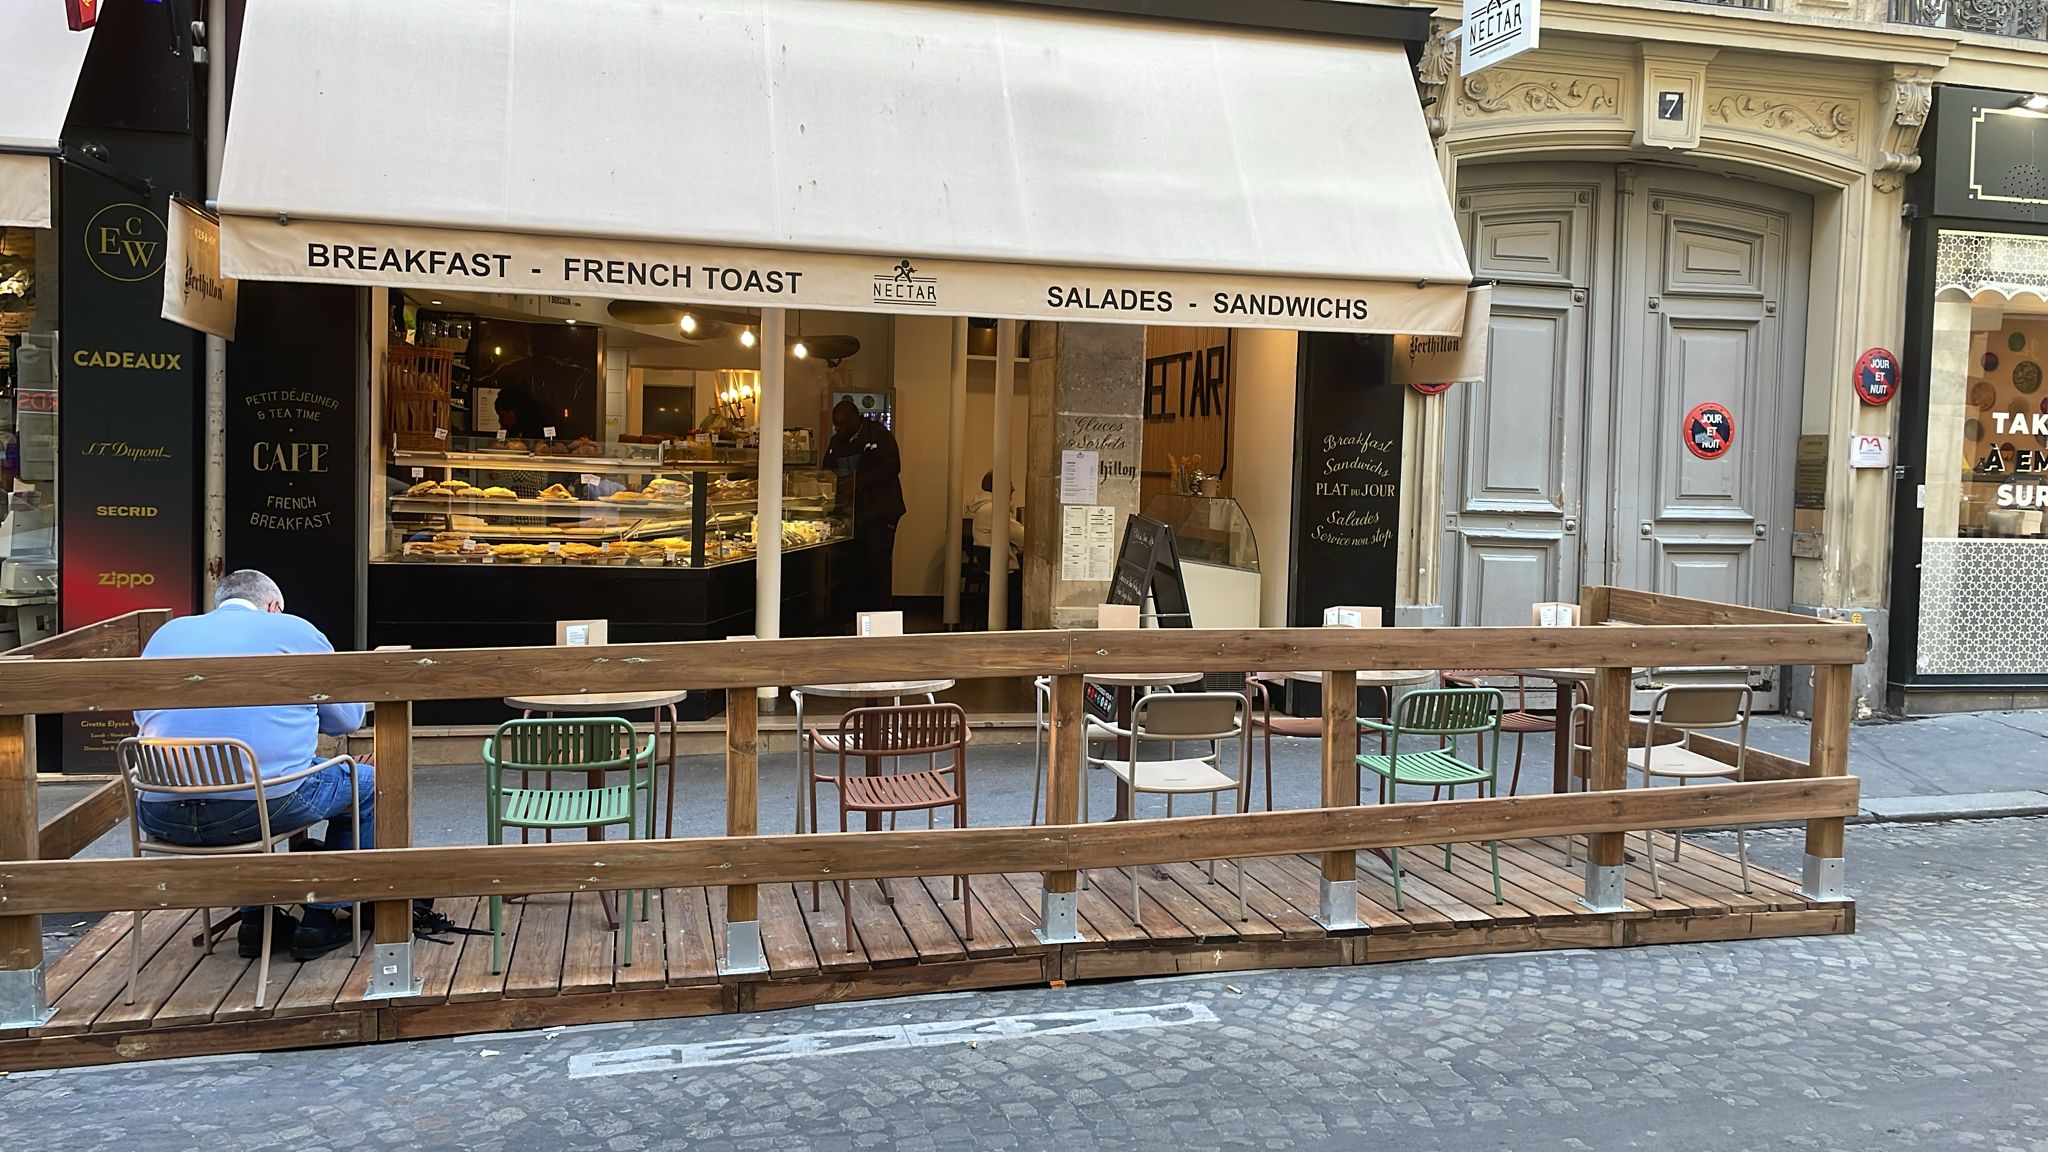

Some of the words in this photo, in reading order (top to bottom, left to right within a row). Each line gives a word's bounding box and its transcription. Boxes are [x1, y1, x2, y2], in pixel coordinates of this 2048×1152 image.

[1469, 3, 1521, 46] NECTAR
[1665, 93, 1680, 118] 7
[308, 243, 512, 278] BREAKFAST
[564, 258, 691, 288] FRENCH
[702, 267, 803, 294] TOAST
[873, 282, 937, 300] NECTAR
[1047, 285, 1173, 312] SALADES
[1213, 292, 1368, 320] SANDWICHS
[73, 350, 182, 370] CADEAUX
[1870, 359, 1889, 369] JOUR
[1144, 346, 1225, 422] ECTAR
[1875, 372, 1885, 381] ET
[245, 391, 278, 406] PETIT
[281, 387, 339, 410] DÉJEUNER
[1870, 385, 1888, 394] NUIT
[269, 408, 292, 418] TEA
[295, 408, 321, 421] TIME
[1701, 414, 1723, 424] JOUR
[1707, 427, 1717, 436] ET
[112, 441, 173, 462] Dupont
[1323, 432, 1394, 453] Breakfast
[1701, 439, 1720, 448] NUIT
[253, 441, 329, 472] CAFE
[1984, 442, 2006, 472] À
[1323, 456, 1390, 477] Sandwichs
[1316, 482, 1349, 496] PLAT
[1350, 488, 1361, 496] DU
[1361, 484, 1395, 497] JOUR
[96, 505, 158, 517] SECRID
[267, 495, 317, 510] FRENCH
[250, 512, 332, 530] BREAKFAST
[1326, 510, 1379, 526] Salades
[1311, 525, 1351, 546] Service
[1351, 535, 1369, 546] non
[1371, 528, 1393, 548] stop
[98, 571, 155, 588] zippo
